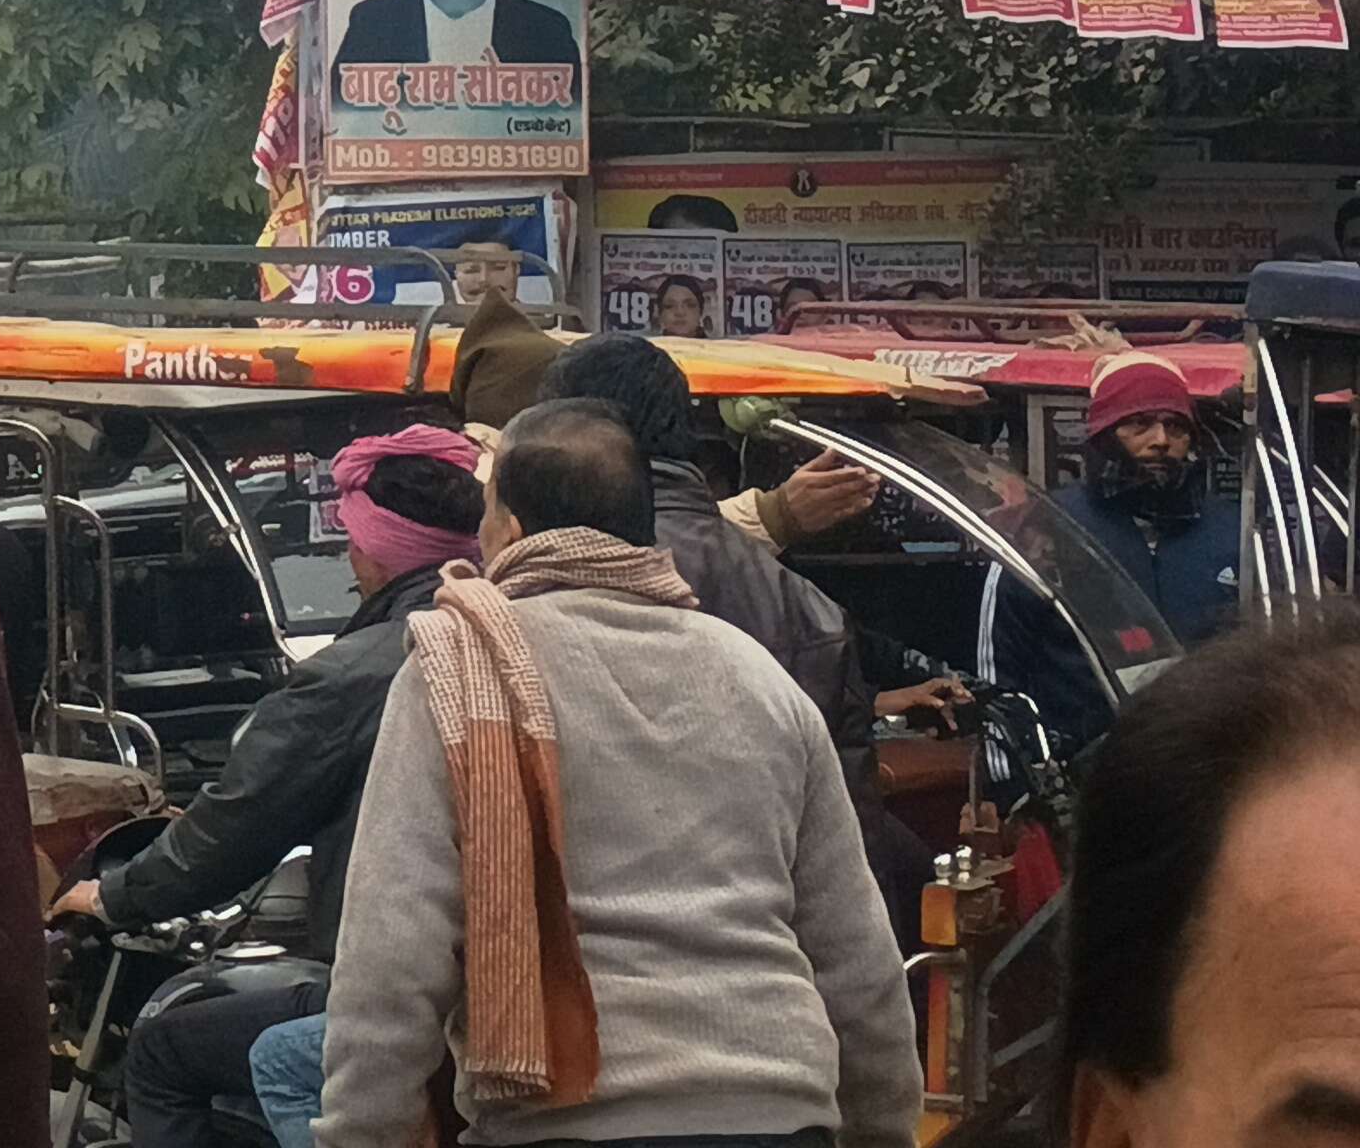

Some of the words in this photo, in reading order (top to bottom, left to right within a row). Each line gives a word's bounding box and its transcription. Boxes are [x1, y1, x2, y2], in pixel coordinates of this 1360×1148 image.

[404, 64, 457, 106] राम
[335, 145, 399, 168] Mob.
[608, 291, 651, 326] 48
[730, 293, 774, 329] 48
[124, 339, 254, 381] Panth
